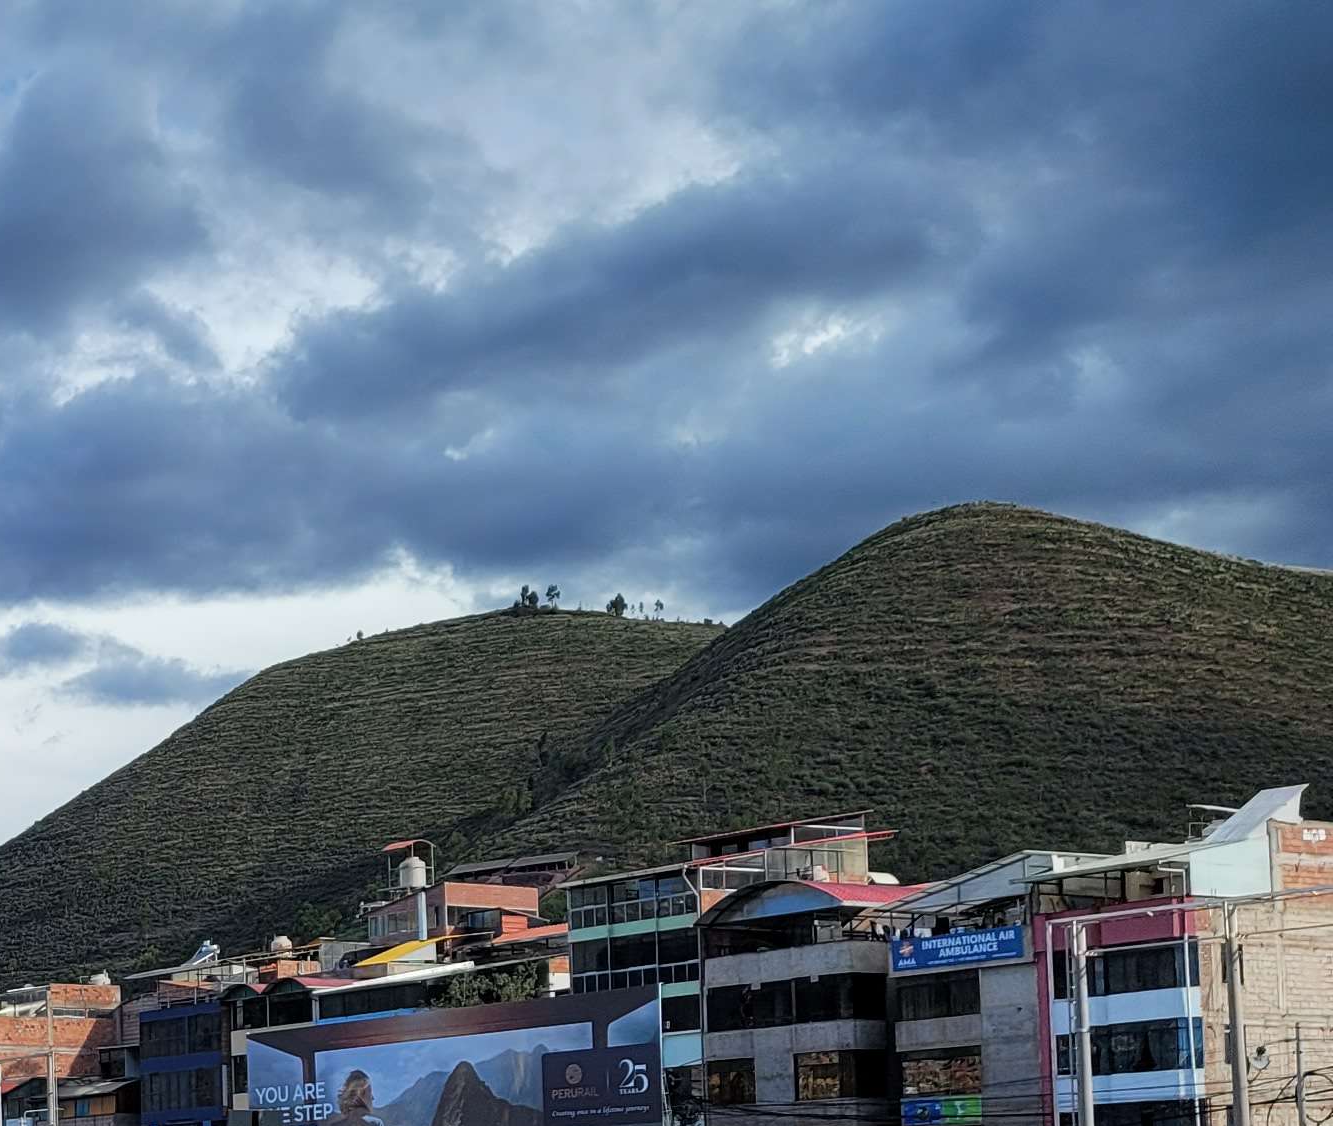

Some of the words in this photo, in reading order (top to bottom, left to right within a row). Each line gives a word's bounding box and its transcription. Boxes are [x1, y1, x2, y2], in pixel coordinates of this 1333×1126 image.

[921, 932, 997, 950] INTERNATIONAL
[998, 930, 1015, 940] AIR
[938, 942, 998, 958] AMBULANCE
[619, 1059, 649, 1093] 25
[255, 1085, 289, 1104] YOU
[293, 1082, 326, 1101] ARE
[552, 1087, 599, 1099] PERURAIL
[294, 1103, 333, 1122] STEP
